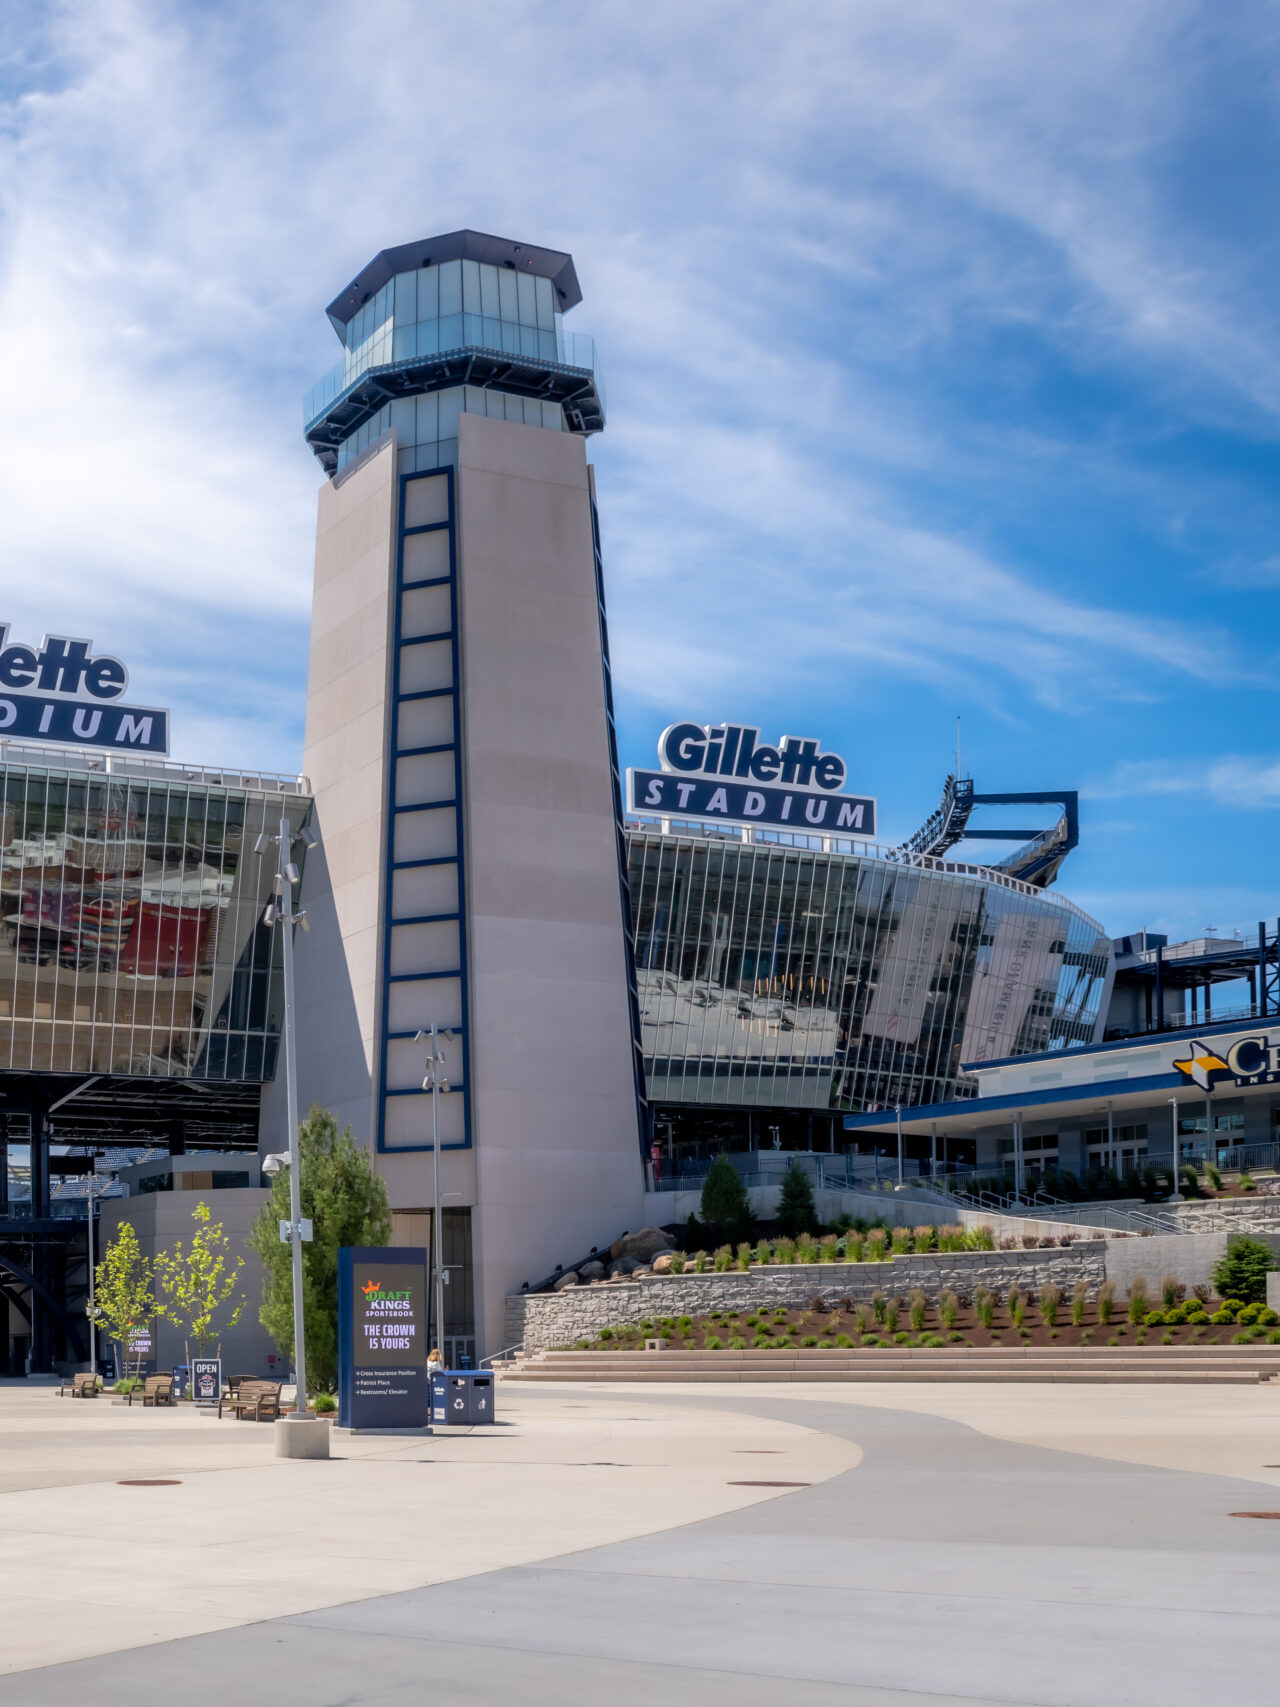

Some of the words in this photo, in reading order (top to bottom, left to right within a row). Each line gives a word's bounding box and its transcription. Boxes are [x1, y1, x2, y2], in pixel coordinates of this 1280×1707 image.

[664, 722, 846, 790] Gillette
[644, 779, 865, 829] STADIUM
[365, 1291, 411, 1301] DRAFT
[370, 1300, 410, 1310] KINGS
[363, 1324, 380, 1336] THE
[382, 1324, 415, 1336] CROWN
[369, 1338, 379, 1349] IS
[380, 1338, 410, 1349] YOURS
[196, 1364, 217, 1373] OPEN
